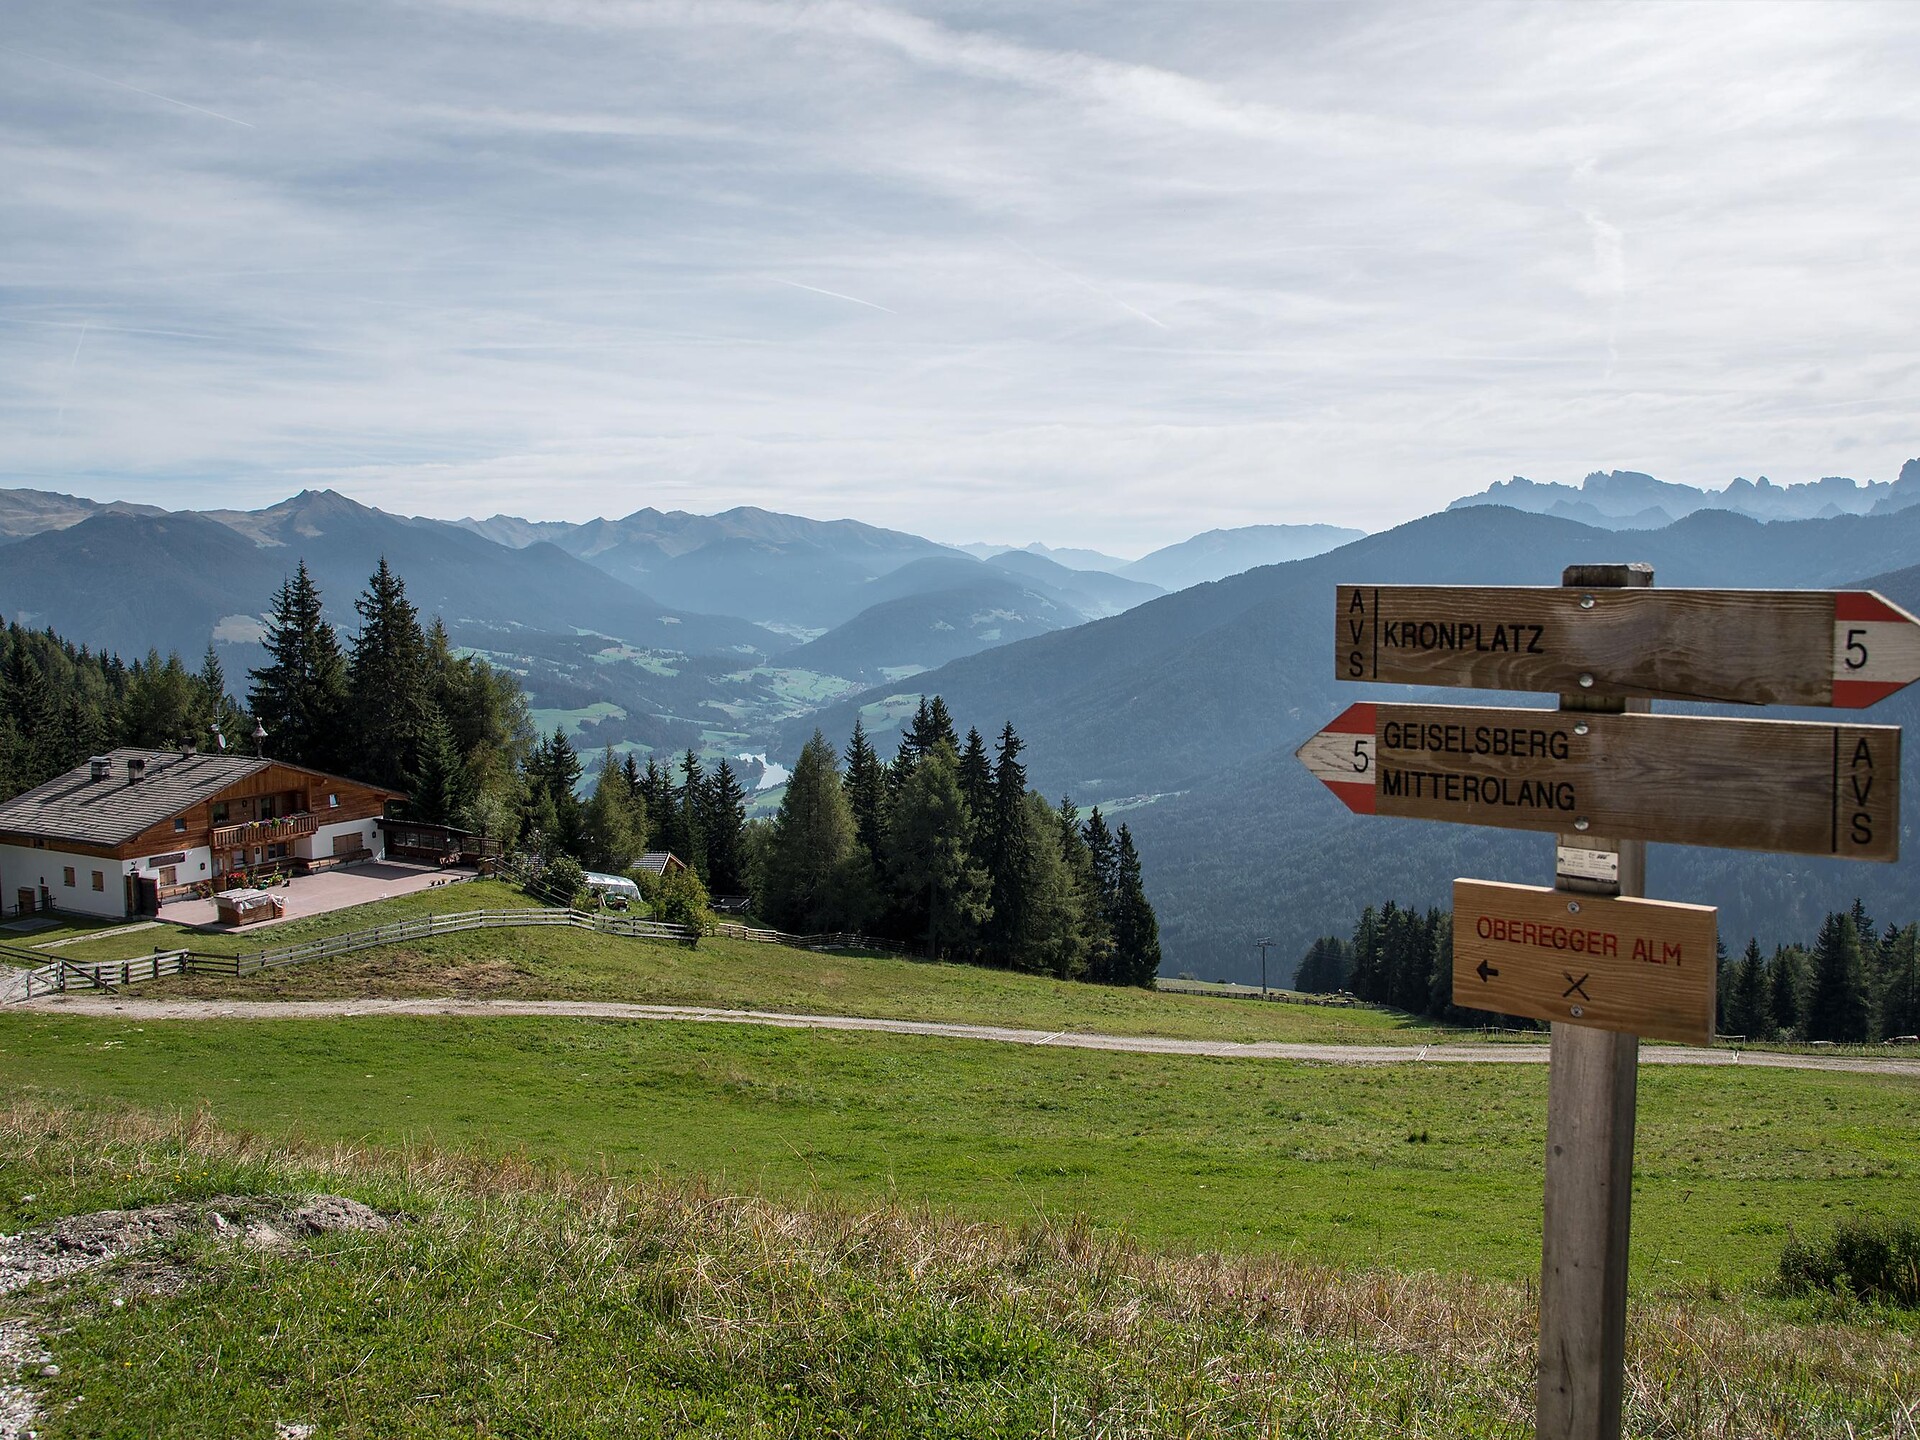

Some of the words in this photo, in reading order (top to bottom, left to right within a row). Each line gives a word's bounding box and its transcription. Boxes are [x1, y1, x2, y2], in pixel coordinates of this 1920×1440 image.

[1349, 588, 1365, 678] AVS
[1383, 620, 1545, 654] KRONPLATZ
[1845, 629, 1868, 669] 5
[1352, 740, 1369, 773] 5
[1382, 721, 1570, 760] GEISELSBERG
[1382, 769, 1576, 811] MITTEROLANG
[1850, 737, 1874, 845] AVS
[1476, 916, 1619, 958] OBEREGGER
[1631, 938, 1682, 967] ALM
